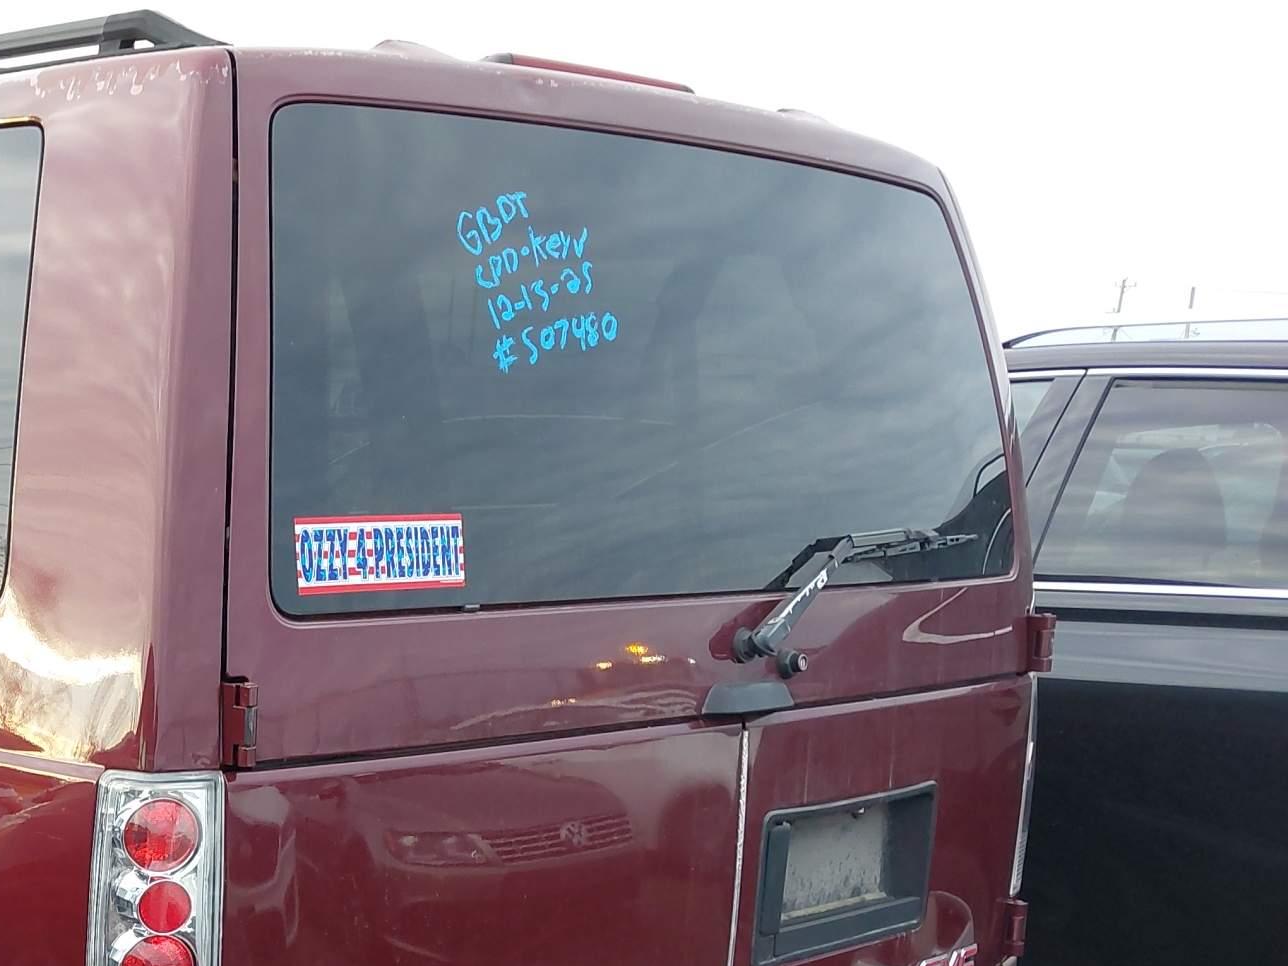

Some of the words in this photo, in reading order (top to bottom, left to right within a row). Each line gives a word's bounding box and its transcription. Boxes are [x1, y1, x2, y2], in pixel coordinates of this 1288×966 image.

[300, 527, 349, 583] OZZY
[355, 526, 368, 580] 4
[373, 523, 461, 579] PRESIDENT
